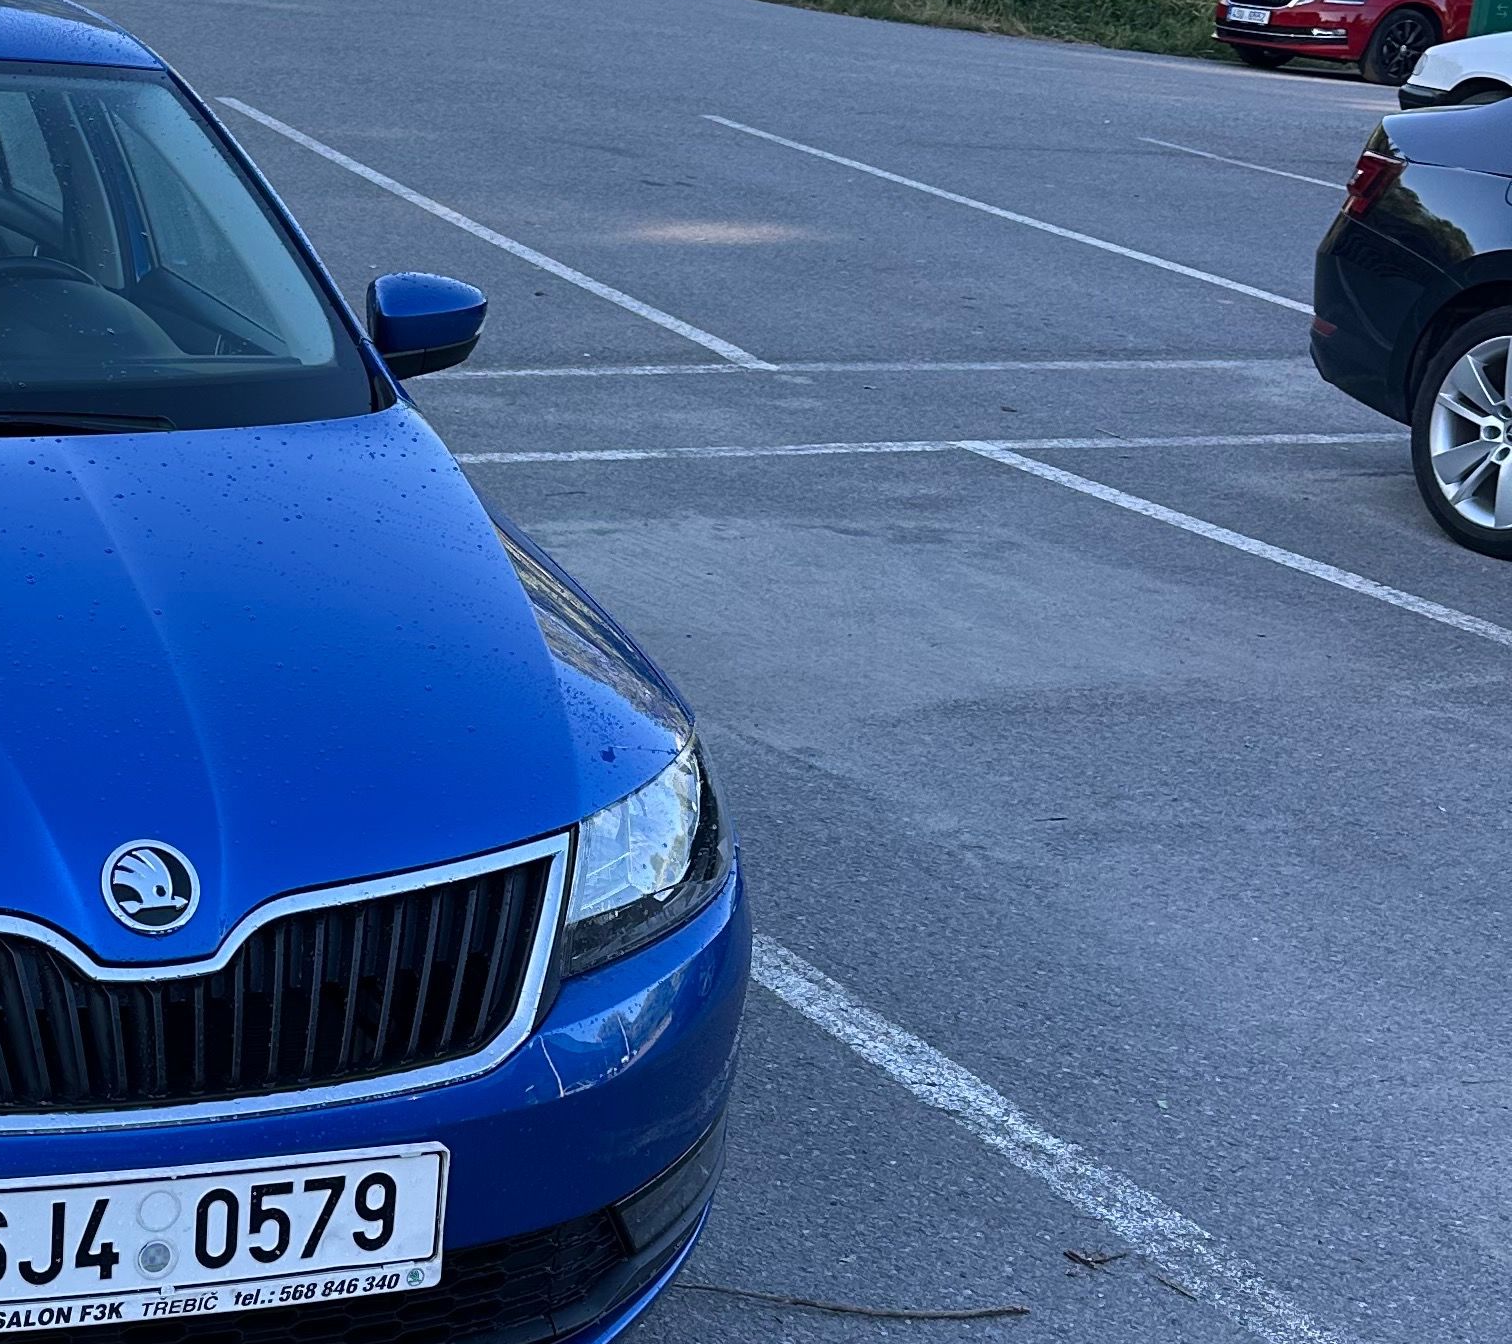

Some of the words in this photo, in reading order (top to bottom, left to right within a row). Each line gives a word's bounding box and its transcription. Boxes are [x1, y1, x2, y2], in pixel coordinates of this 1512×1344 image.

[194, 1172, 398, 1269] 0579
[79, 1301, 124, 1323] F3K
[141, 1291, 219, 1317] TŘEBÍČ
[278, 1282, 317, 1304] 568
[321, 1277, 358, 1298] 846
[362, 1272, 400, 1292] 340
